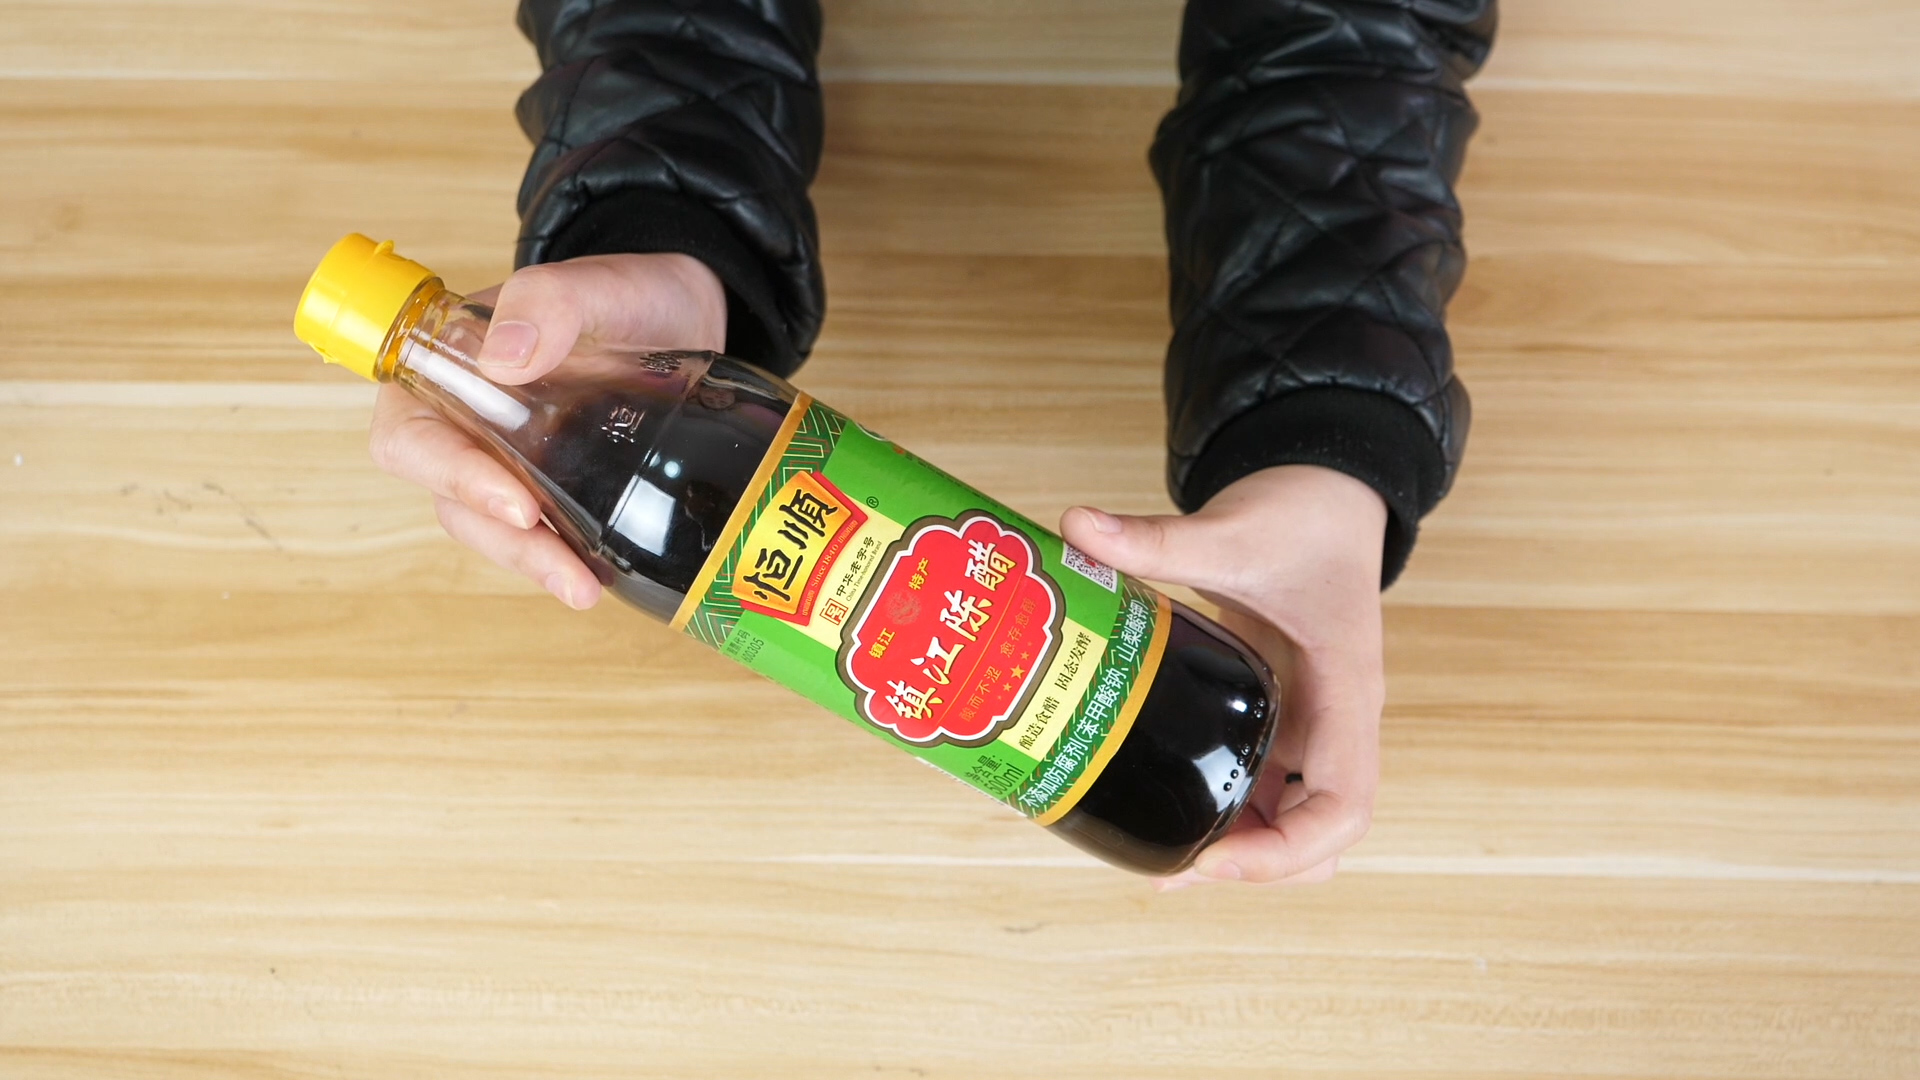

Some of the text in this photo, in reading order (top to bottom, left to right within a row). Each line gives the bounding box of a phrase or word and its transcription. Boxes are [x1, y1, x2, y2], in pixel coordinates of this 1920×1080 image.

[821, 543, 839, 566] 1840
[836, 536, 875, 597] 中华老字号
[845, 540, 882, 602] China Time-honored Brand
[868, 558, 930, 659] 镇江 特产
[885, 539, 1017, 721] 镇江陈醋
[959, 598, 1037, 722] 酸而不涩 愈存愈醇
[1019, 632, 1092, 751] 酿造食醋 固态发酵
[983, 762, 1025, 796] 500ml
